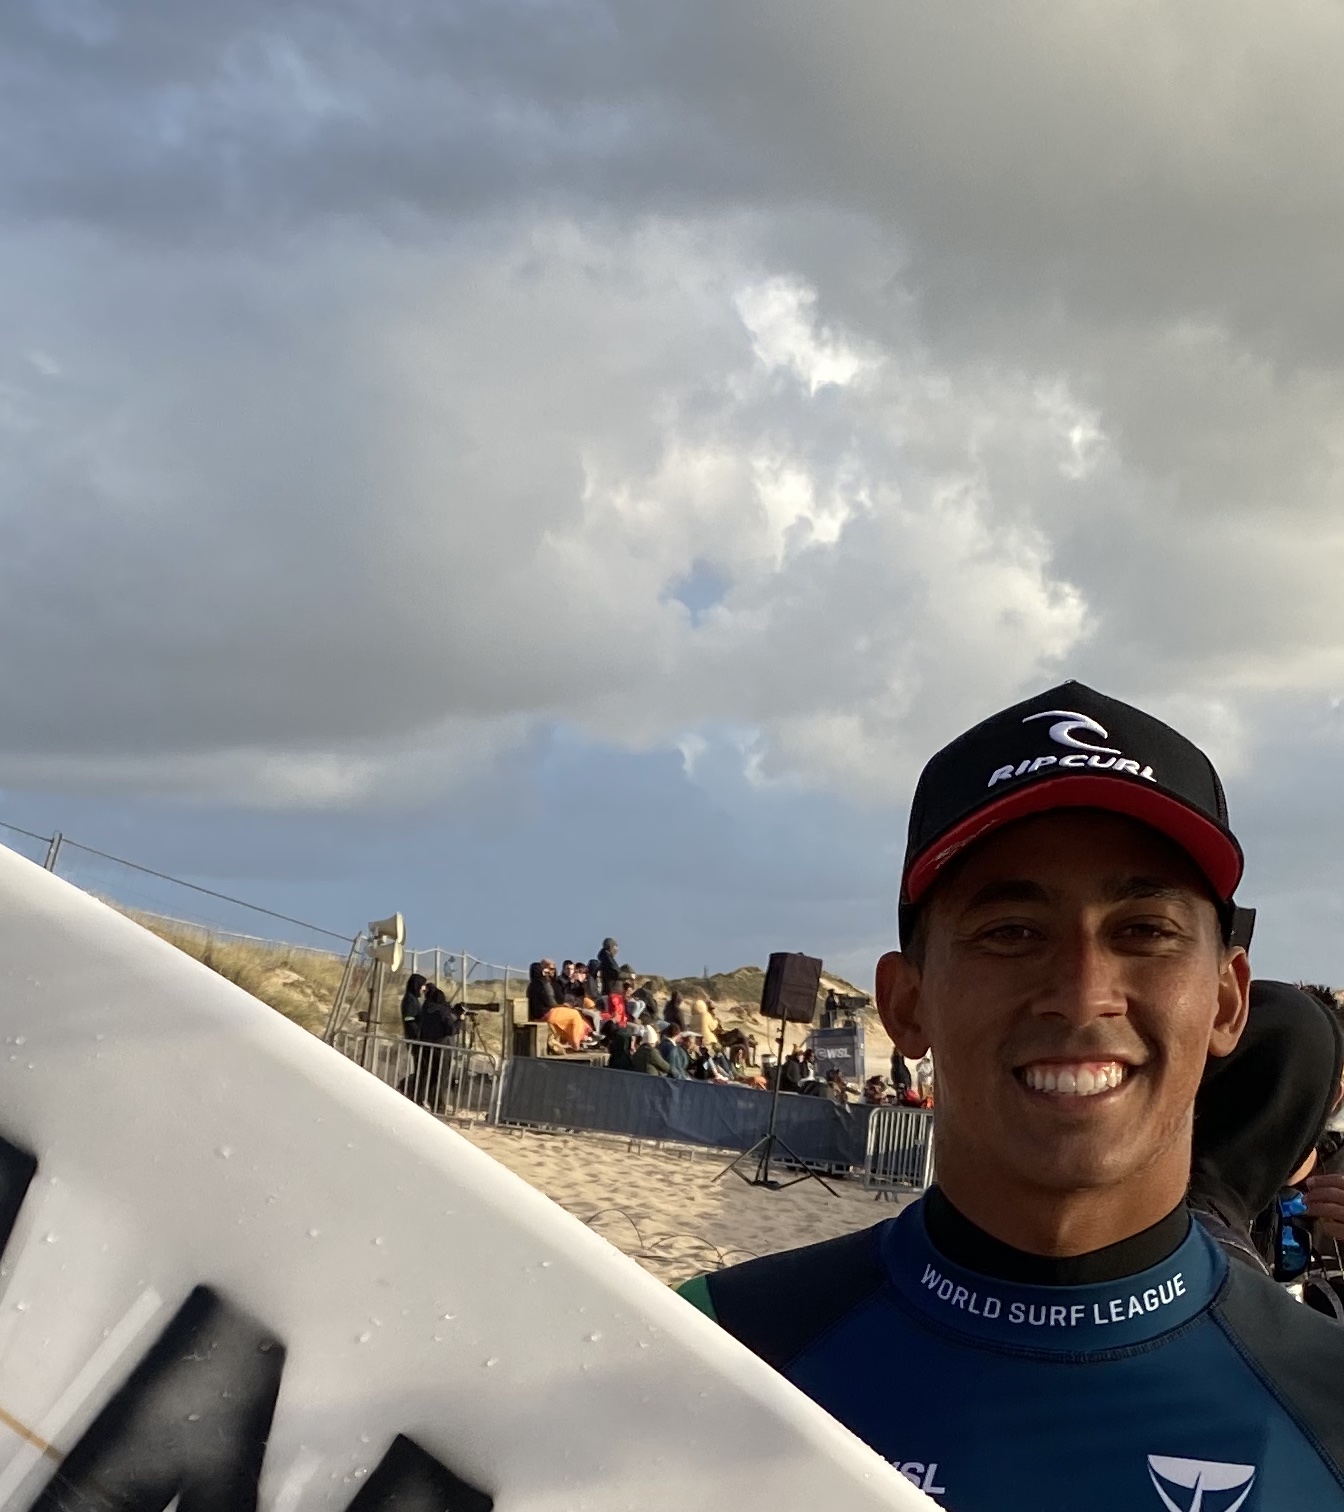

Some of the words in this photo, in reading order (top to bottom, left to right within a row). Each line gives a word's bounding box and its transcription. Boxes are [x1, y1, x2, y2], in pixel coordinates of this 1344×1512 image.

[826, 1047, 852, 1060] WSL
[919, 1262, 1002, 1320] WORLD
[1008, 1301, 1086, 1327] SURF
[1092, 1272, 1187, 1326] LEAGUE
[891, 1461, 947, 1495] SL
